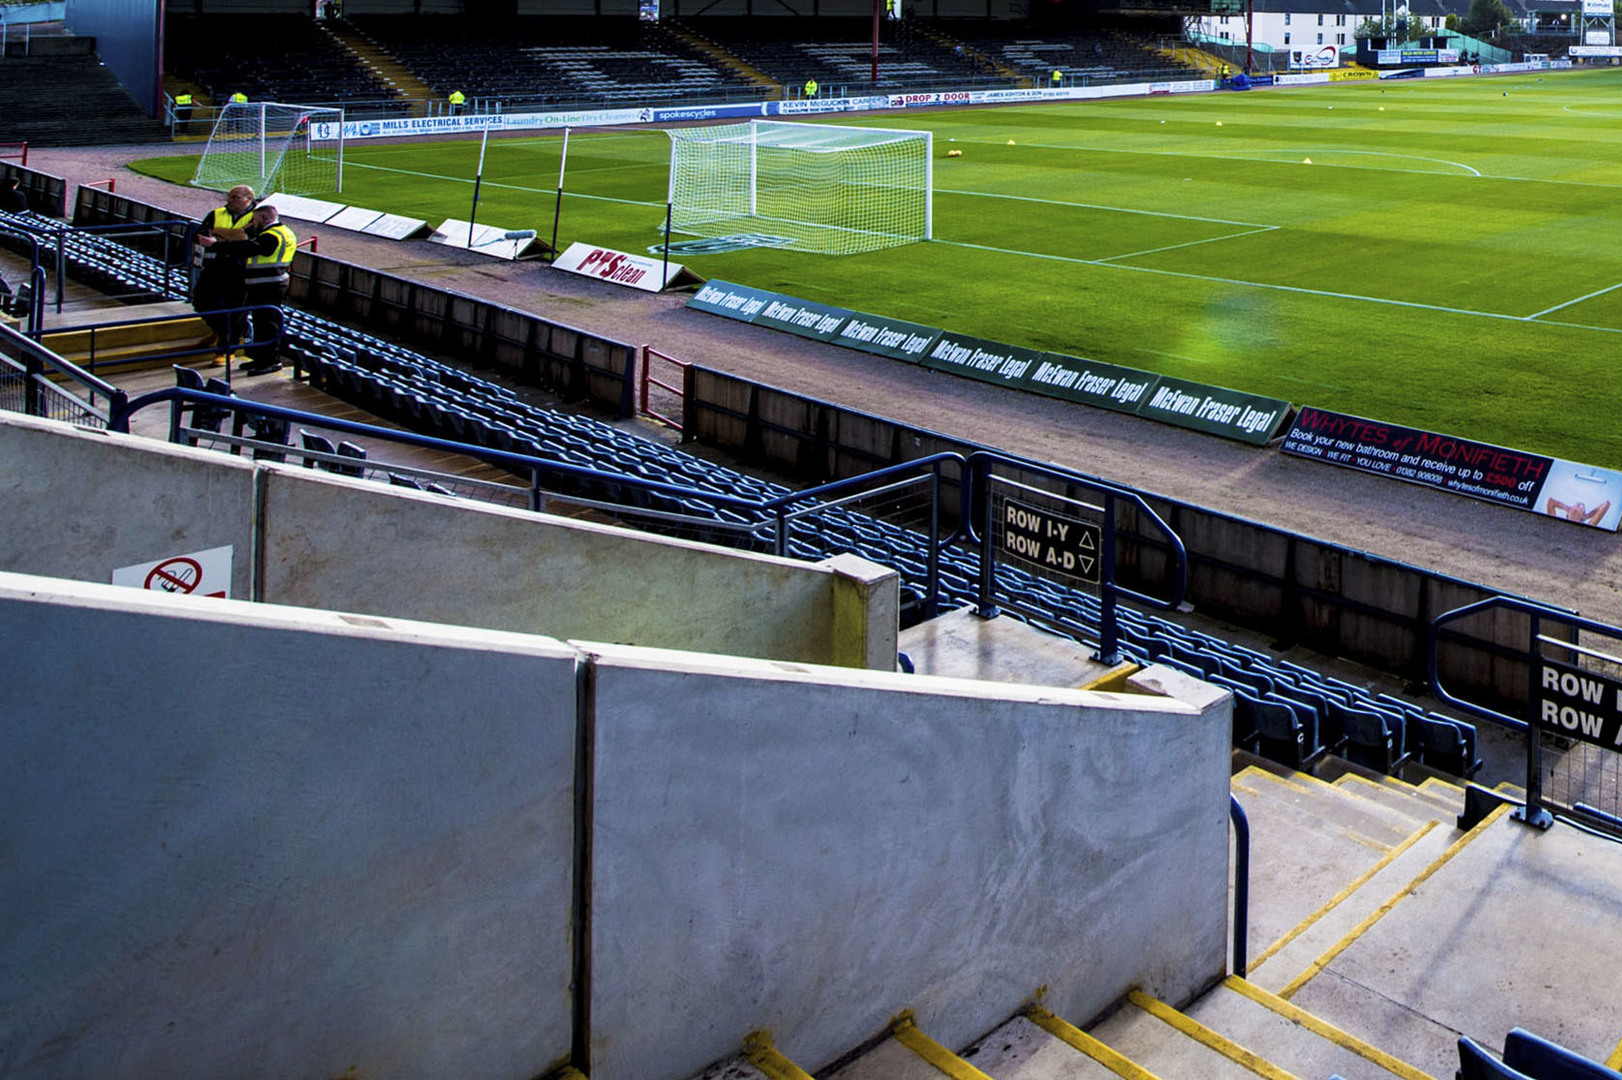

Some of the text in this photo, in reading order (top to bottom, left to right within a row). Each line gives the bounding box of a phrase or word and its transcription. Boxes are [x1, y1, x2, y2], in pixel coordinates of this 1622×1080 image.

[660, 108, 716, 121] spokescycles
[809, 98, 850, 108] McGUCKIN
[905, 94, 931, 103] DROP
[944, 92, 970, 101] DOOR
[383, 115, 503, 130] MILLS ELECTRICAL SERVICES
[507, 116, 543, 127] Laundry
[545, 114, 580, 124] On-Line
[840, 319, 933, 355] McEwan Fraser Legal
[931, 340, 1032, 380] McEwan Fraser Legal
[1031, 361, 1148, 404] McEwan Fraser Legal
[1149, 386, 1277, 433] McEwan Fraser Legal
[1290, 428, 1535, 493] Book your new bathroom and receive up to £500 off
[1301, 409, 1545, 479] WHYTES of MONIFIETH
[1284, 441, 1529, 506] WE DESIGN WE FIT YOU LOVE 01382 908008 whytesofmonifieth.co.uk
[1007, 506, 1069, 541] ROW I-Y
[1006, 531, 1075, 570] ROW A-D
[1542, 666, 1604, 705] ROW
[1541, 699, 1603, 738] ROW
